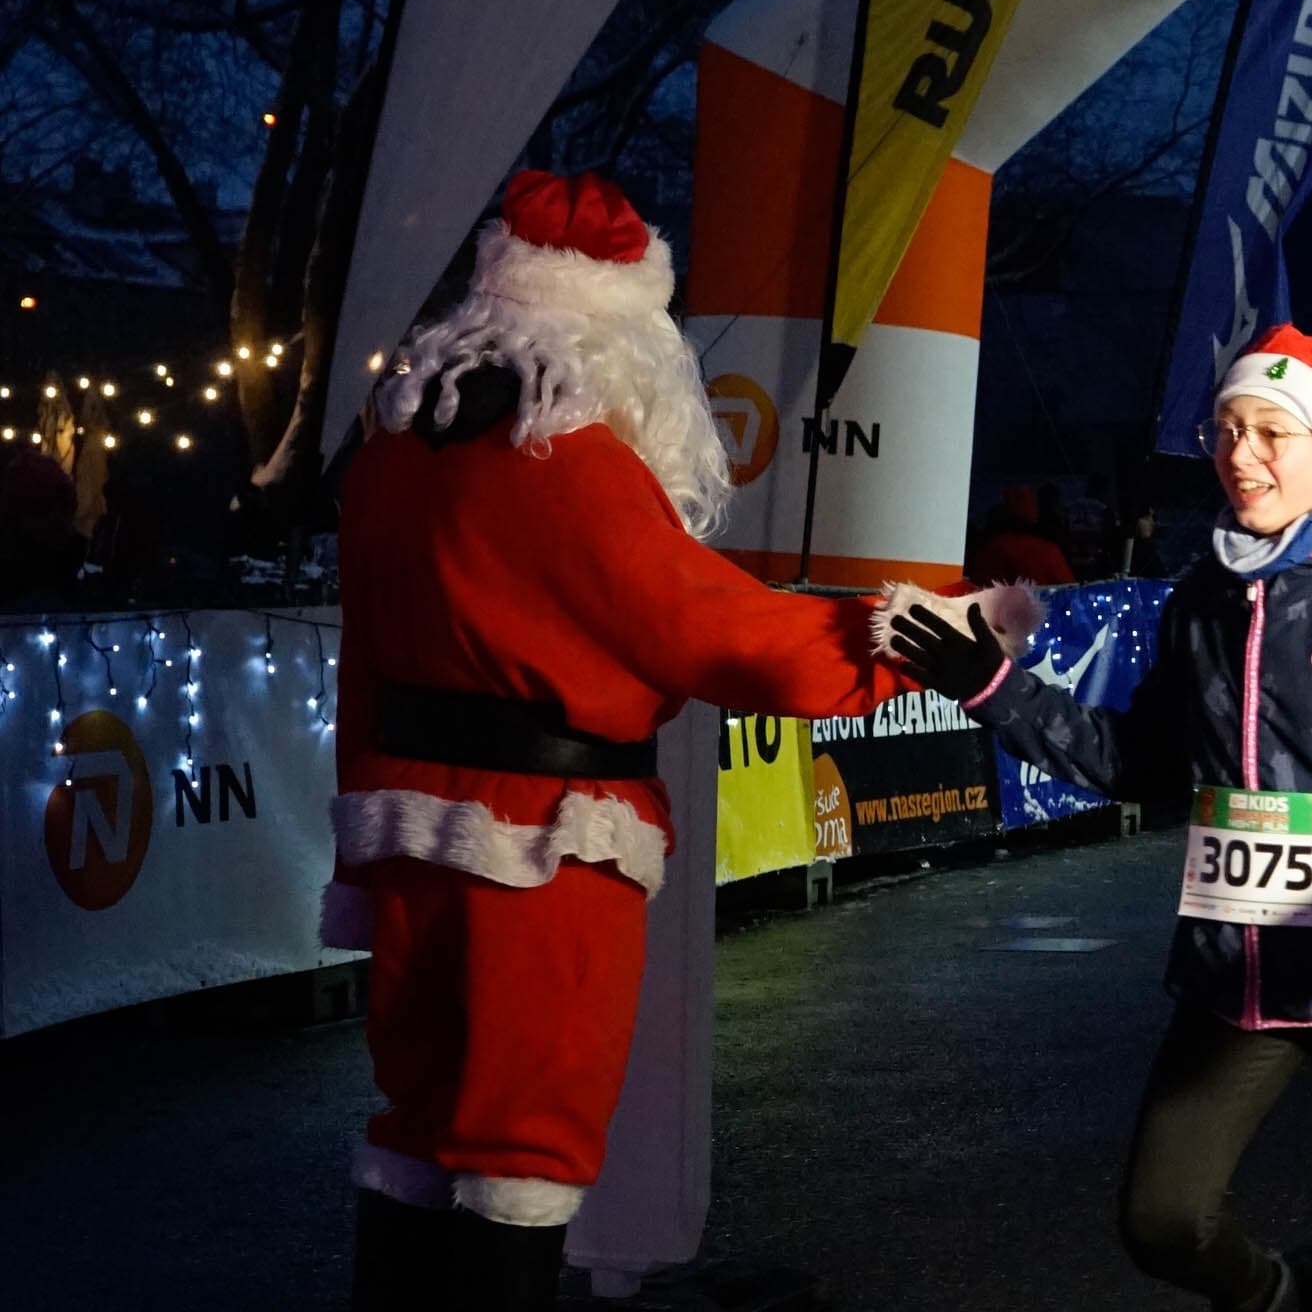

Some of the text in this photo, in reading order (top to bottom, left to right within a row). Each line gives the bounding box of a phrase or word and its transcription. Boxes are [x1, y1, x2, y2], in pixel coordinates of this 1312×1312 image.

[801, 417, 880, 458] NN
[812, 688, 984, 743] EGION ZDARM
[172, 760, 257, 827] NN
[855, 783, 989, 826] www.nasregion.cz
[1248, 794, 1289, 813] KIDS
